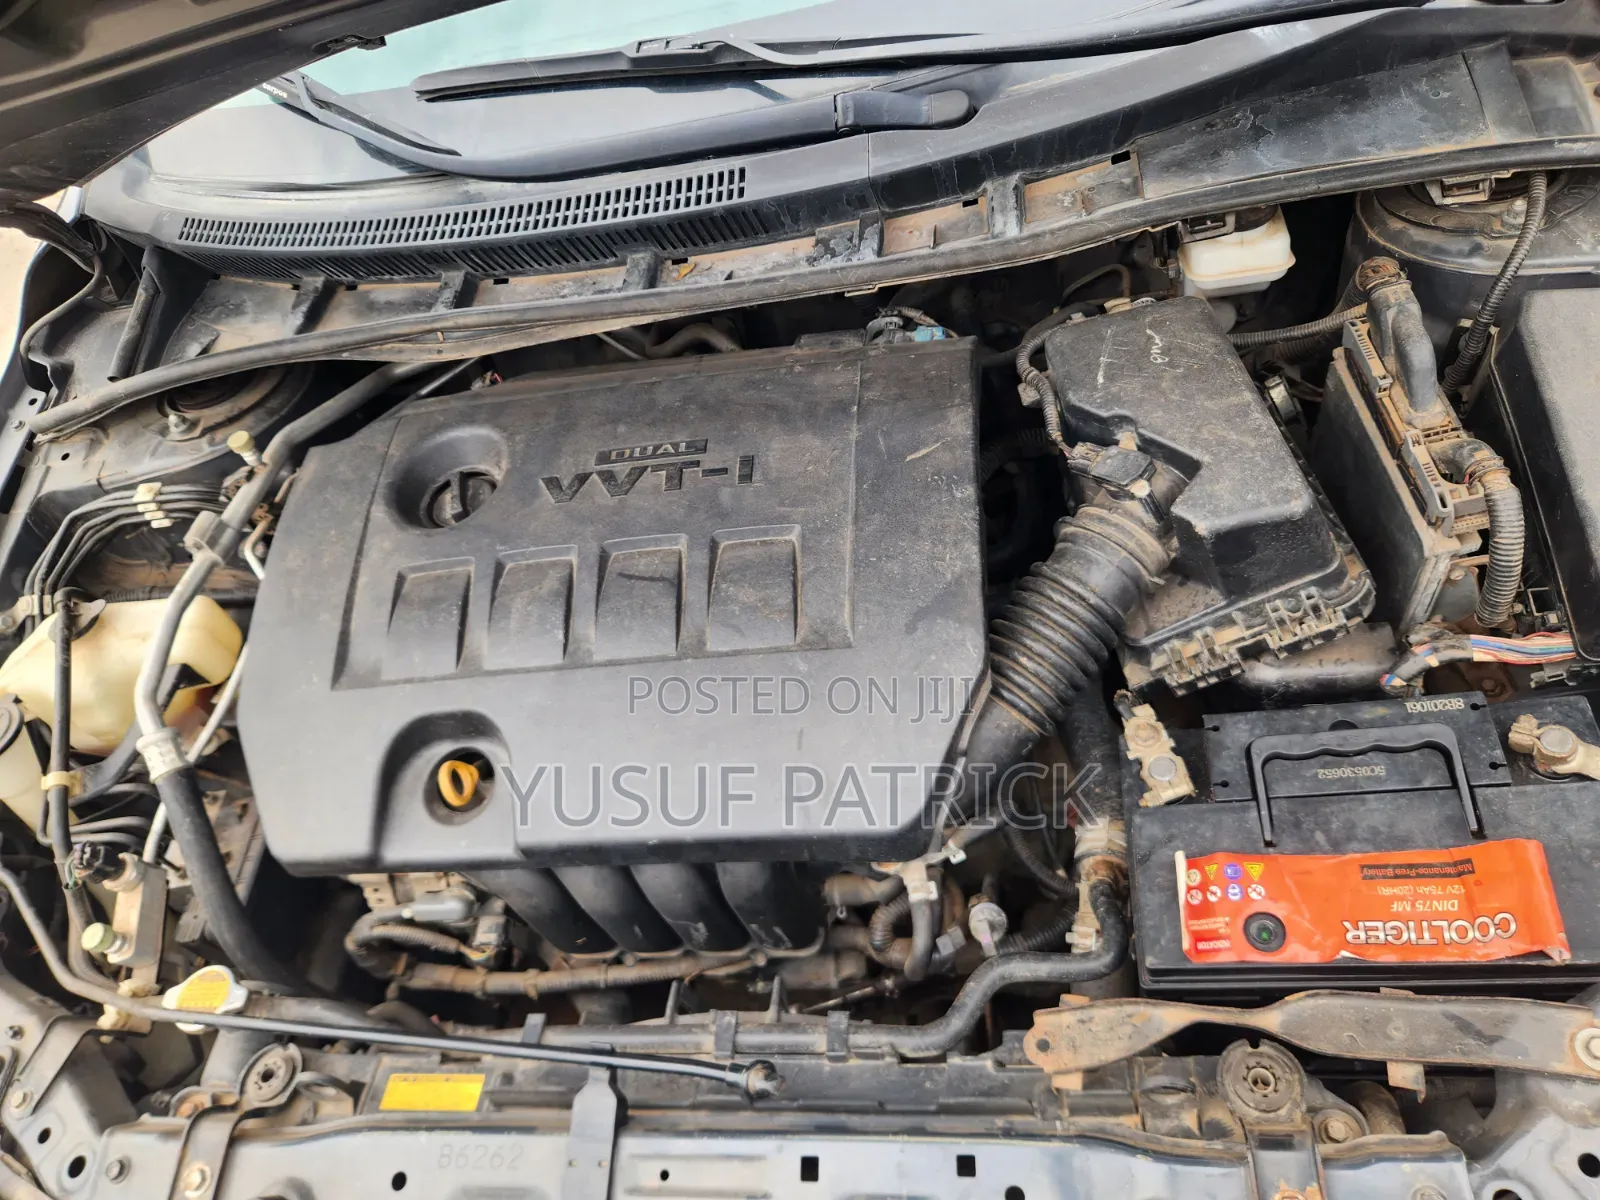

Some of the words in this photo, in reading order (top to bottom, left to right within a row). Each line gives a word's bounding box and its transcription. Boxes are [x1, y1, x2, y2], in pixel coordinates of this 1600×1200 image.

[609, 442, 696, 460] DUAL
[540, 455, 754, 503] VVT-I
[1404, 697, 1465, 713] 8B201061
[1317, 765, 1387, 779] 5C0530652
[1361, 864, 1393, 877] Battery
[1377, 884, 1414, 897] (20HR)
[1416, 885, 1443, 896] 75Ah
[1446, 884, 1466, 895] 12V
[1390, 901, 1412, 912] MF
[1415, 900, 1458, 912] DIN75
[1342, 911, 1518, 946] COOLTIGER
